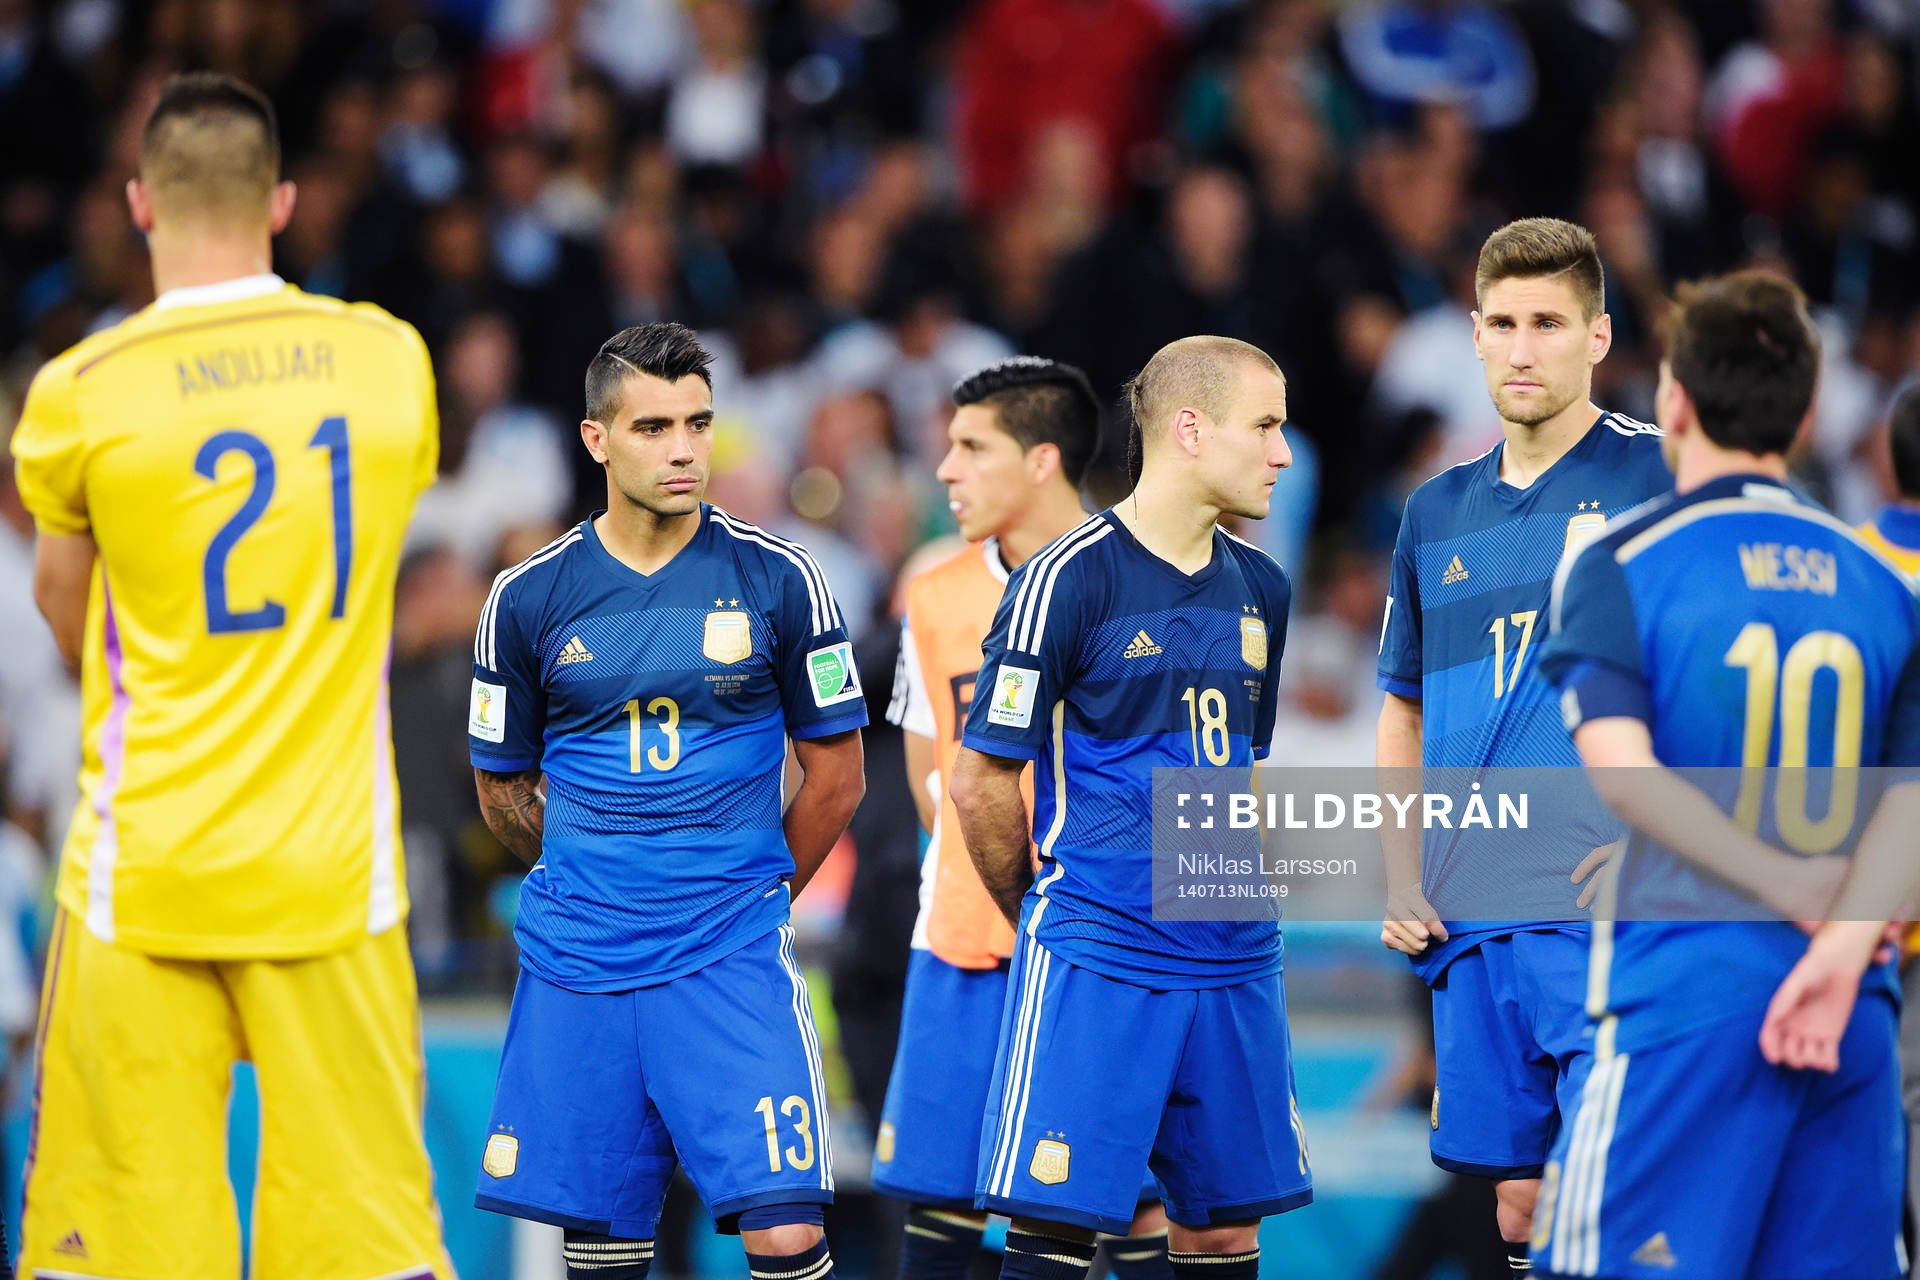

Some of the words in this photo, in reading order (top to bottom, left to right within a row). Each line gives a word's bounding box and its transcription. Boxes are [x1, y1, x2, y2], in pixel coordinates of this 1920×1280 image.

[177, 342, 335, 398] ANDUJAR
[194, 416, 352, 634] 21
[1738, 543, 1838, 597] MESSI
[557, 651, 594, 665] adidas
[1123, 645, 1163, 659] adidas
[1489, 610, 1537, 699] 17
[621, 696, 680, 773] 13
[1181, 687, 1230, 766] 18
[1724, 621, 1865, 854] 10
[754, 1095, 814, 1173] 13
